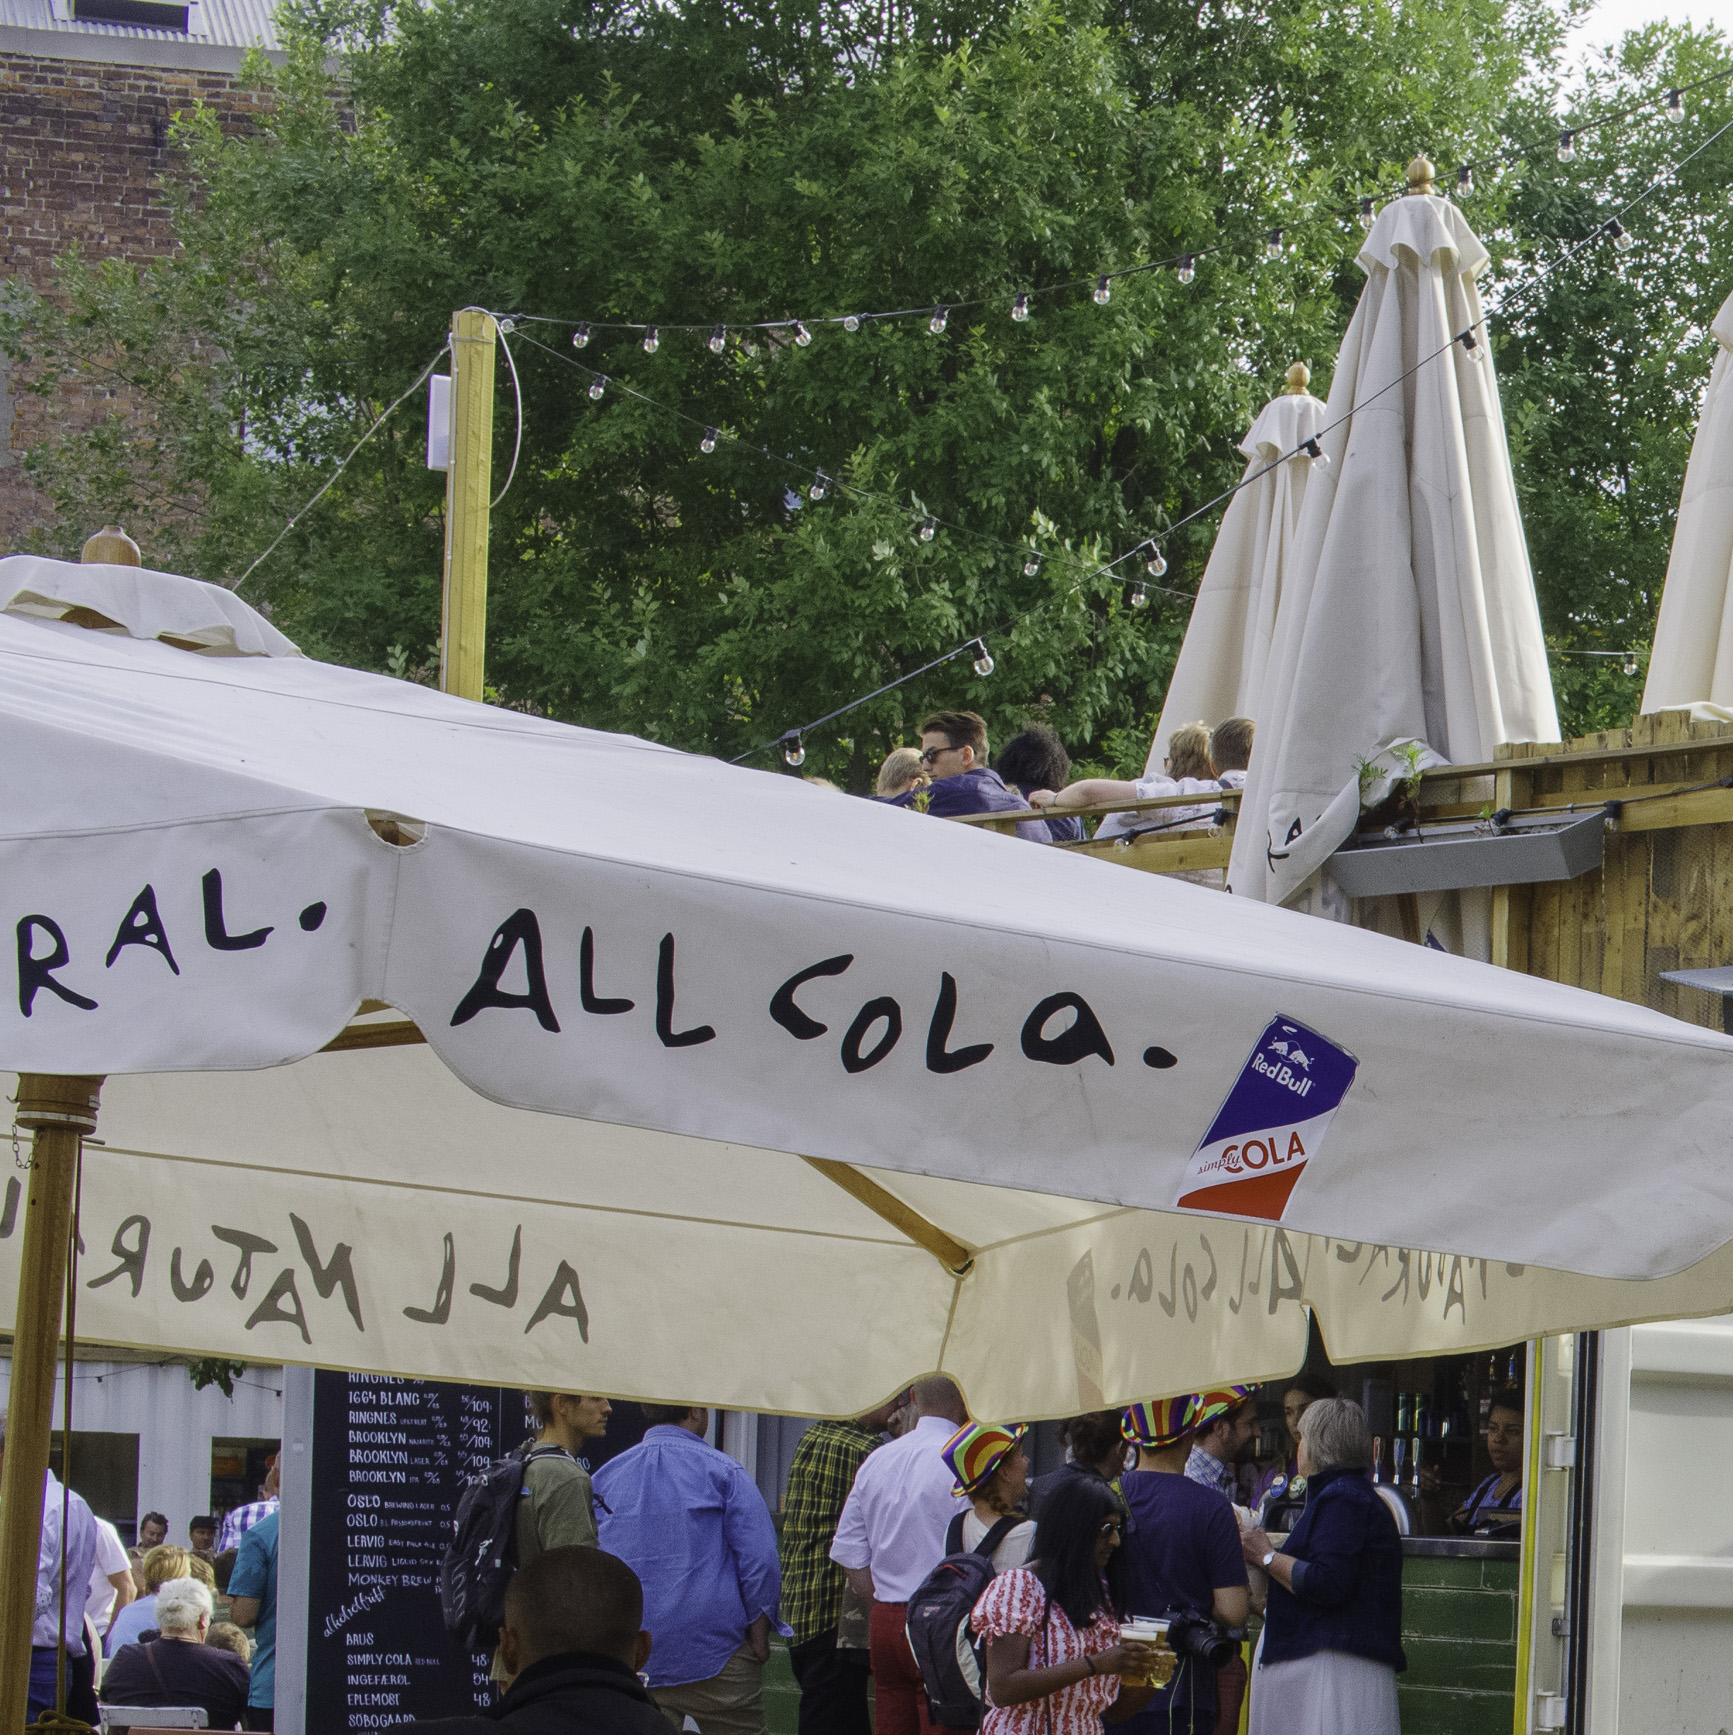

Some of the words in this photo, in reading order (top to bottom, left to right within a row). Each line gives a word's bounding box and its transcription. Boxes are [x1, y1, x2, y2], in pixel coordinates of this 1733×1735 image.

[450, 908, 716, 1049] ALL
[1252, 1053, 1281, 1079] Red
[1276, 1066, 1312, 1097] Bull
[1198, 1152, 1240, 1174] simply
[1222, 1131, 1305, 1174] COLA
[348, 1391, 377, 1405] 1664
[349, 1410, 397, 1425] RINGNES
[348, 1430, 406, 1445] BROOKLYN
[349, 1449, 408, 1465] BROOKLYN
[349, 1470, 406, 1484] BROOKLYN
[347, 1494, 381, 1508] OSLO
[346, 1513, 378, 1527] OSLO
[347, 1535, 385, 1548] LERVIG
[348, 1554, 388, 1568] LERVIG
[348, 1572, 399, 1587] MONKEY
[401, 1574, 432, 1587] BREW
[346, 1632, 374, 1646] BRUS
[347, 1653, 383, 1666] SIMPLY
[385, 1653, 413, 1666] COLA
[347, 1692, 400, 1706] EPLEMOST
